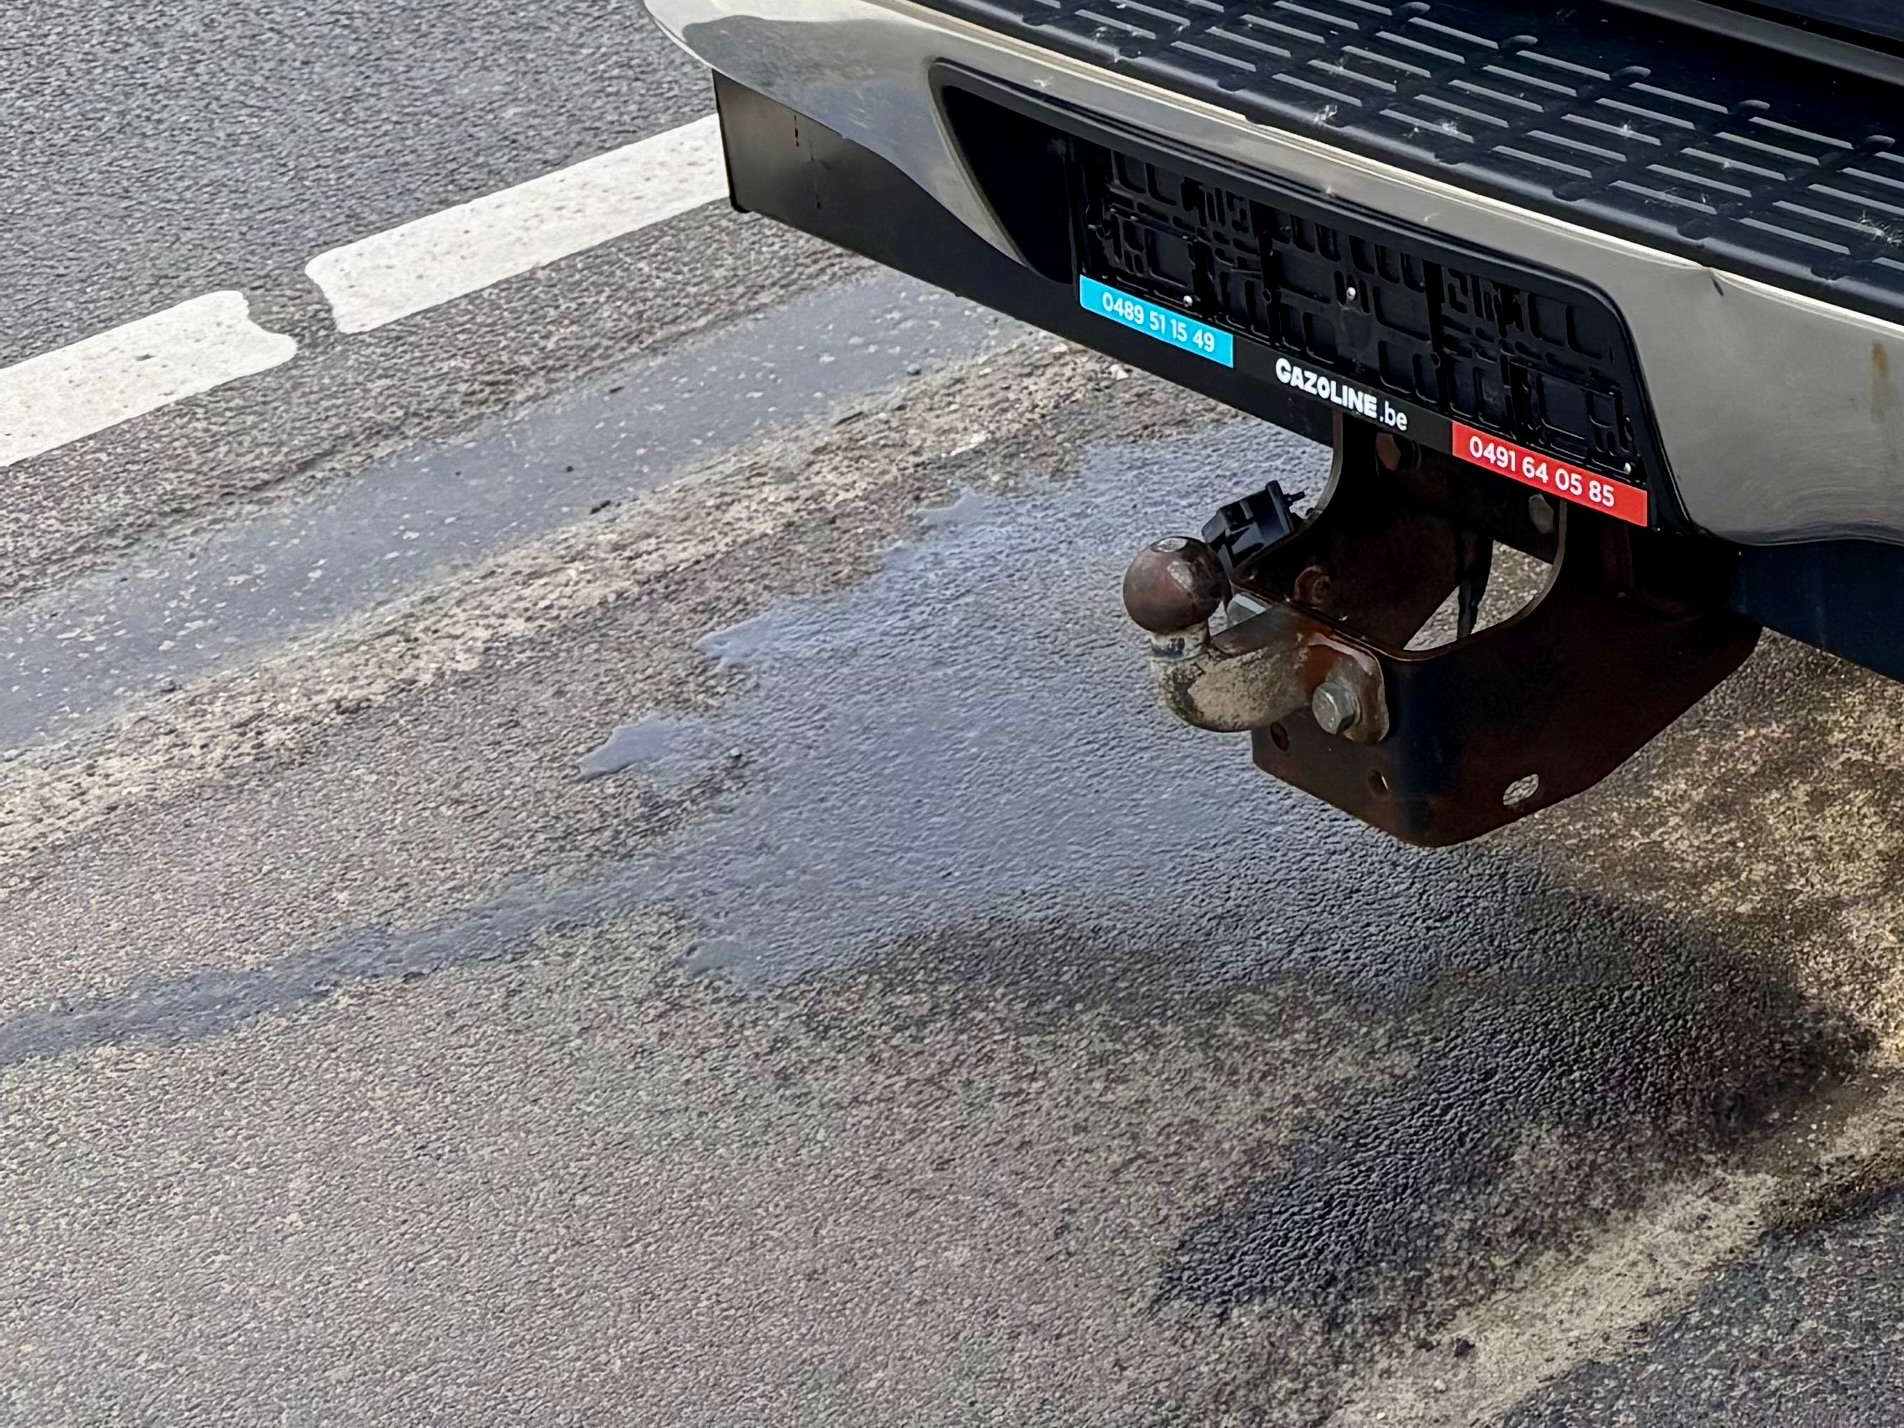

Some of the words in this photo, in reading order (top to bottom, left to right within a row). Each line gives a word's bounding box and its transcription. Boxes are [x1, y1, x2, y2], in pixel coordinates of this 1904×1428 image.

[1102, 291, 1145, 325] 0489
[1149, 311, 1166, 335] 51
[1171, 319, 1188, 343] 15
[1192, 328, 1215, 353] 49
[1274, 357, 1408, 431] GAZOLINE.be
[1469, 435, 1516, 472] 0491
[1521, 456, 1549, 483] 64
[1555, 468, 1583, 496] 05
[1588, 480, 1615, 507] 85
